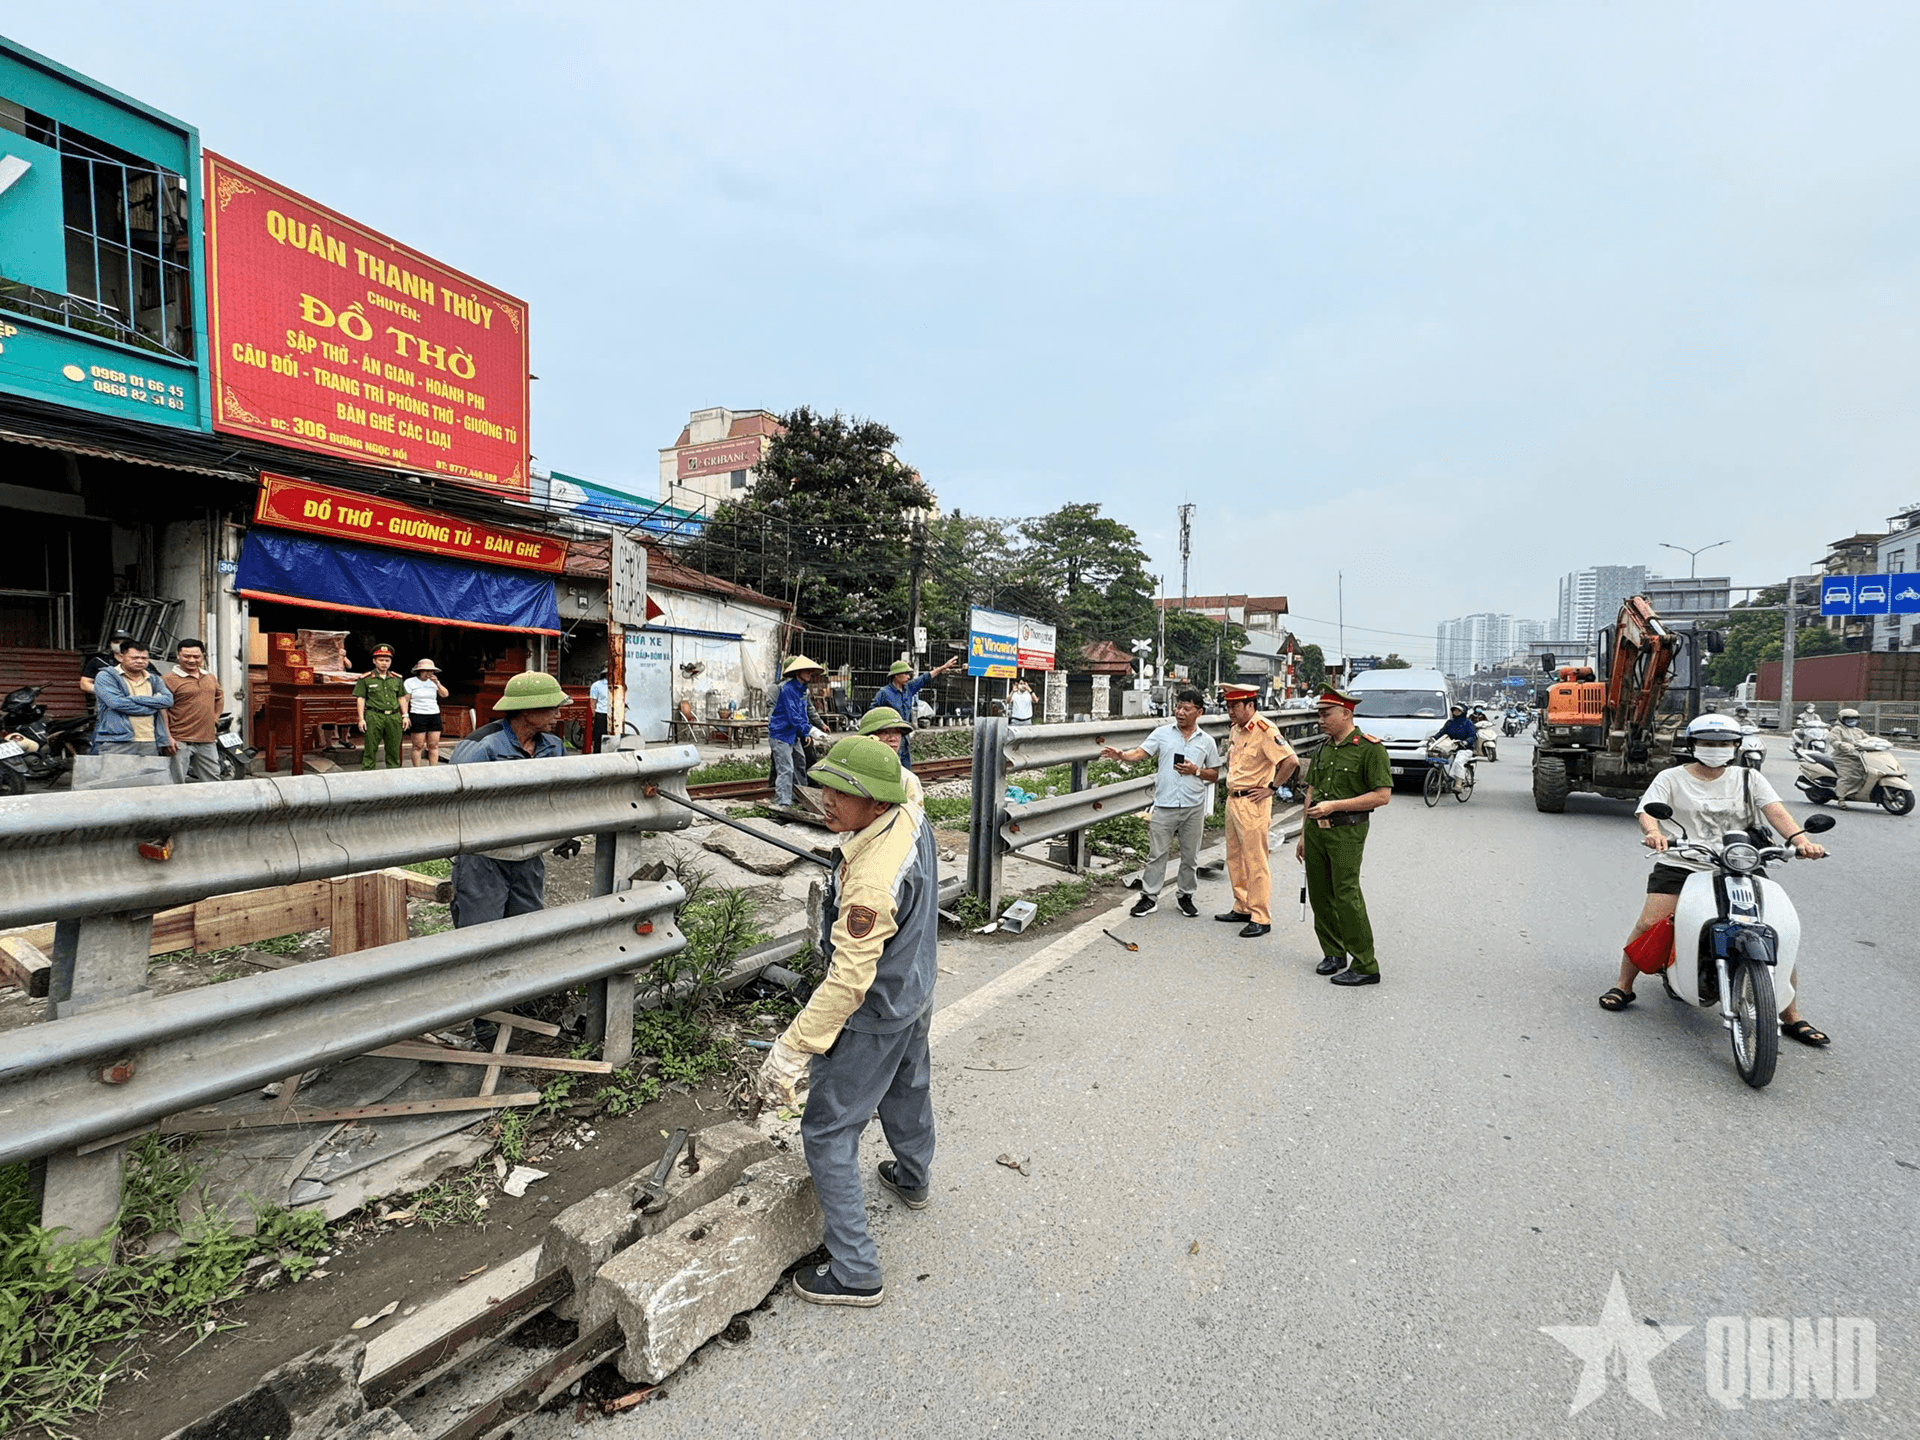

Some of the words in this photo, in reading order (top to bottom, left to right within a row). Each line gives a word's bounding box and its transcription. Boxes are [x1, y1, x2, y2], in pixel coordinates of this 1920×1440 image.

[266, 209, 347, 268] QUÂN
[354, 247, 434, 306] THANH
[441, 287, 494, 330] THỦY
[367, 290, 421, 323] CHUYÊN:
[299, 292, 373, 342] ĐỒ
[386, 326, 476, 380] THỜ
[90, 365, 126, 384] 0968
[129, 374, 144, 388] 01
[147, 379, 165, 393] 66
[168, 385, 184, 398] 45
[286, 329, 317, 355] SẬP
[320, 341, 349, 365] THỜ
[361, 353, 381, 376] ÁN
[384, 362, 415, 387] GIAN
[425, 377, 464, 404] HOÀNH
[467, 391, 485, 411] PHI
[93, 380, 127, 397] 0868
[131, 389, 147, 402] 82
[231, 342, 267, 369] CÂU
[271, 353, 298, 379] ĐỐI
[312, 366, 360, 397] TRANG
[363, 382, 384, 404] TRÍ
[387, 390, 430, 418] PHÒNG
[432, 404, 454, 425] THỜ
[464, 415, 502, 440] GIƯỜNG
[505, 426, 517, 444] TỦ
[292, 417, 327, 440] 306
[336, 401, 366, 426] BÀN
[369, 412, 396, 434] GHẾ
[398, 420, 423, 441] CÁC
[426, 428, 451, 450] LOẠI
[303, 498, 331, 521] ĐỒ
[337, 506, 374, 528] THỜ
[388, 516, 450, 544] GIƯỜNG
[454, 527, 473, 547] TỦ
[484, 535, 514, 554] BÀN
[220, 562, 239, 573] 306
[649, 636, 662, 647] XE
